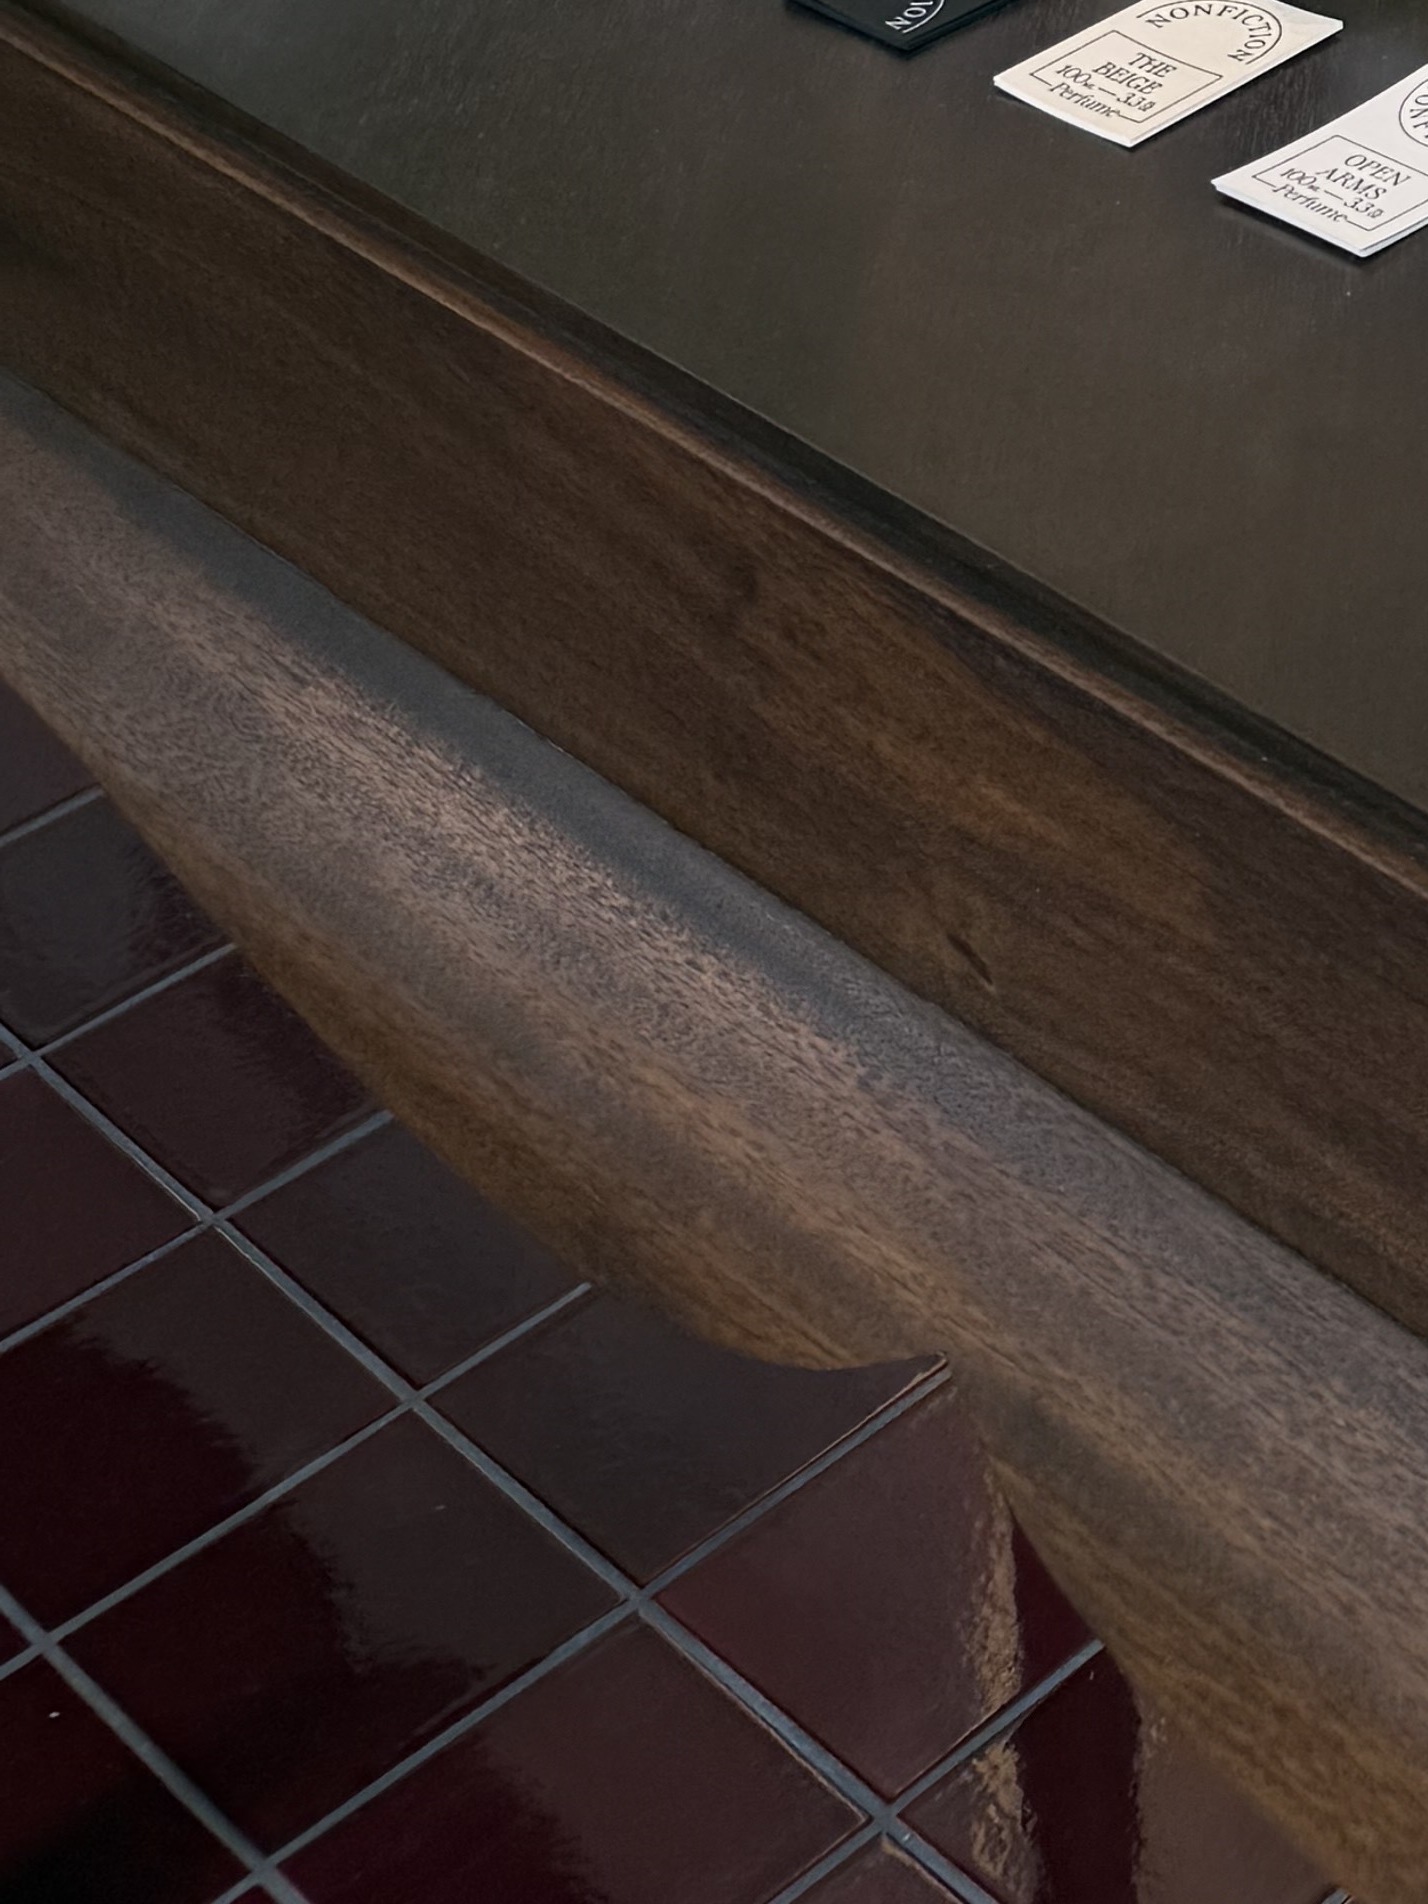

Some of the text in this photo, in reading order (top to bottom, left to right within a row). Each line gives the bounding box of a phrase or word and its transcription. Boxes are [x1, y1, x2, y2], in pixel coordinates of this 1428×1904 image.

[1145, 2, 1273, 62] NONFICTION
[1091, 60, 1162, 96] BEIGE
[1128, 52, 1177, 78] THE
[1322, 167, 1388, 201] ARMS
[1344, 153, 1411, 188] OPEN
